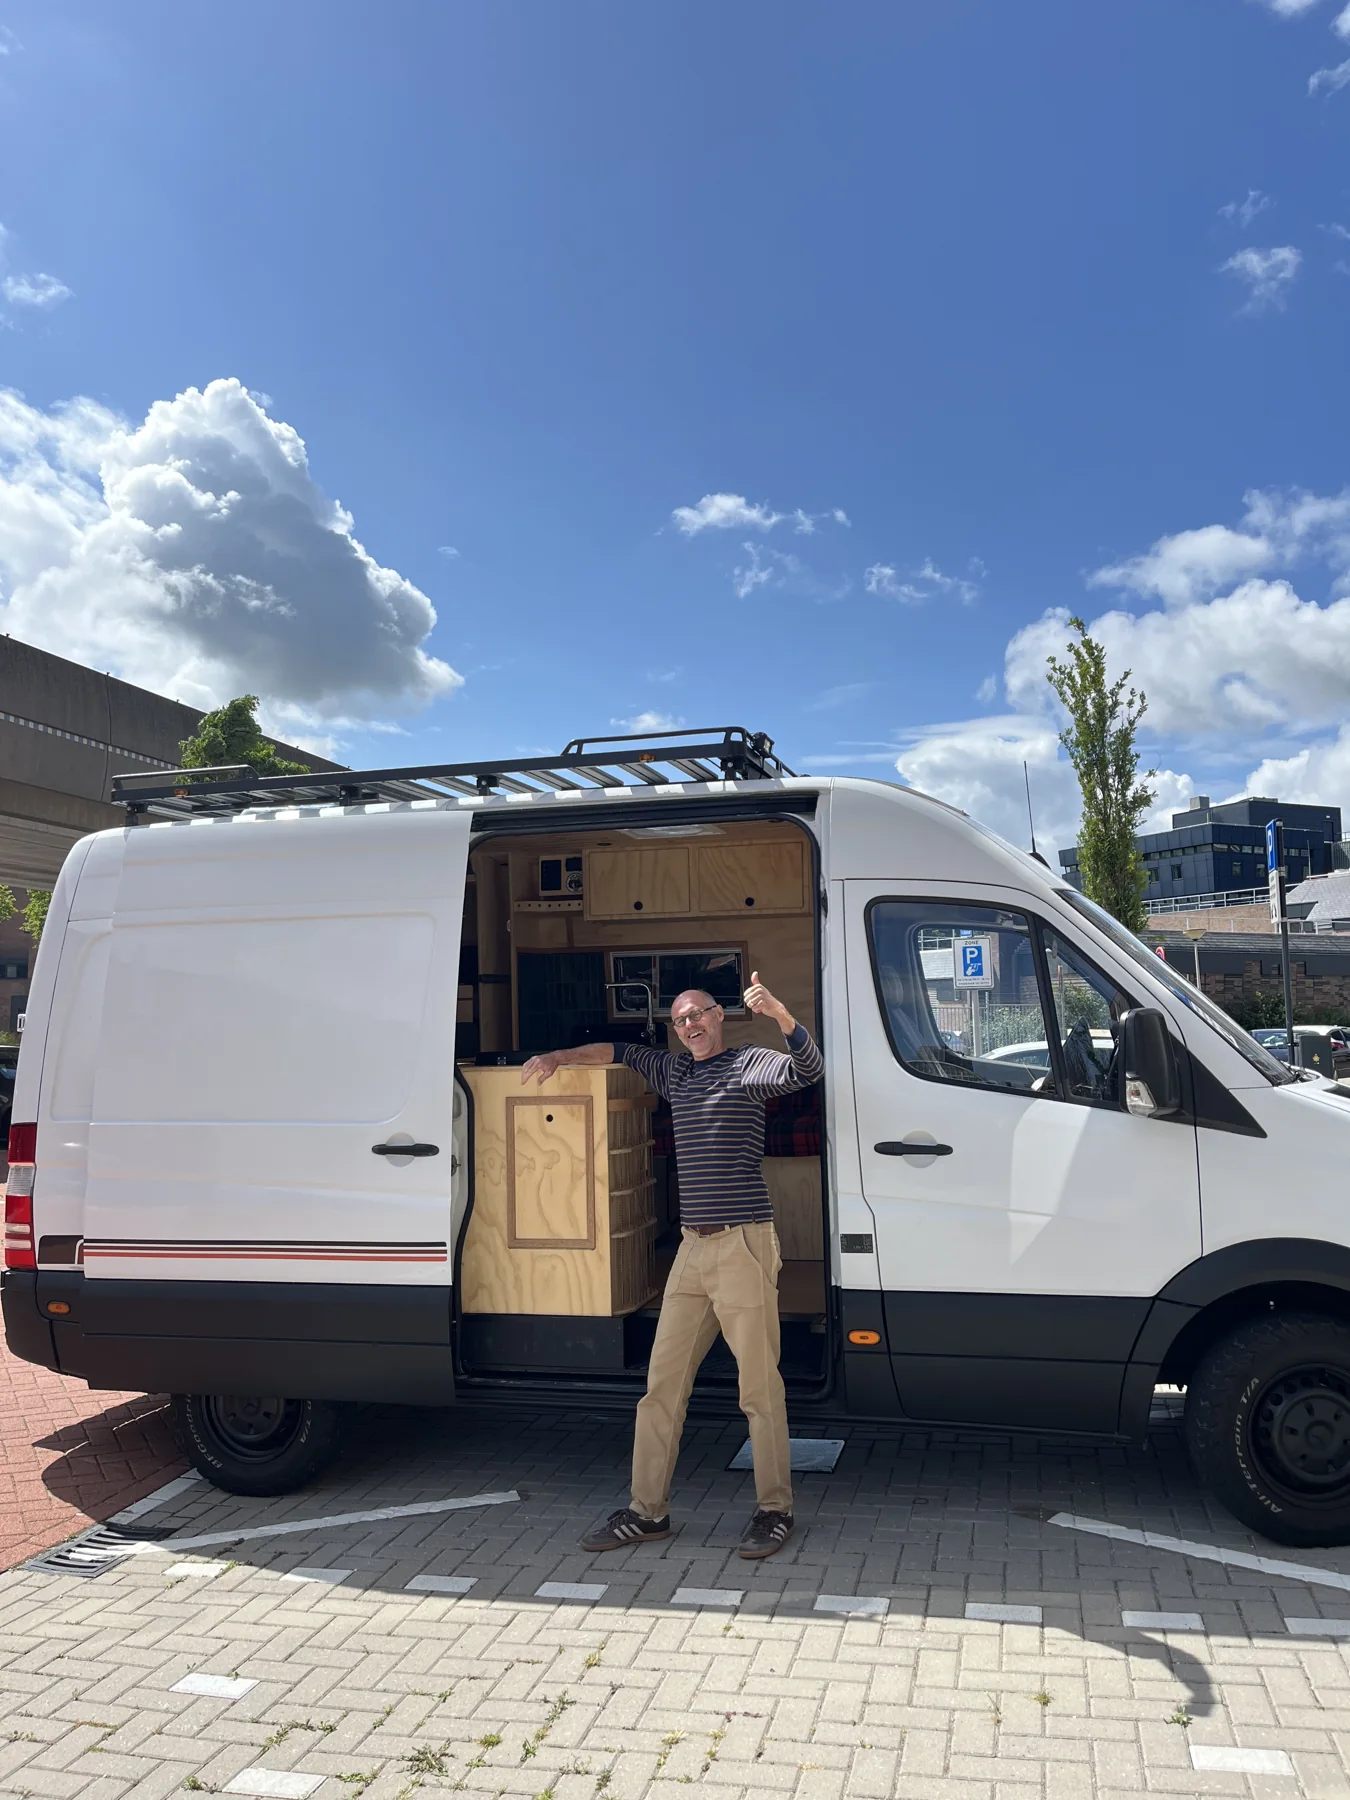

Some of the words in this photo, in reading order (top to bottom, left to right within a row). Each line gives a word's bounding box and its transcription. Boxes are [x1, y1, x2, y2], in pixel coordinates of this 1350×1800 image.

[1267, 829, 1273, 866] P
[966, 947, 979, 964] P
[1240, 1377, 1260, 1404] T/A
[1235, 1414, 1283, 1513] All-Terrain
